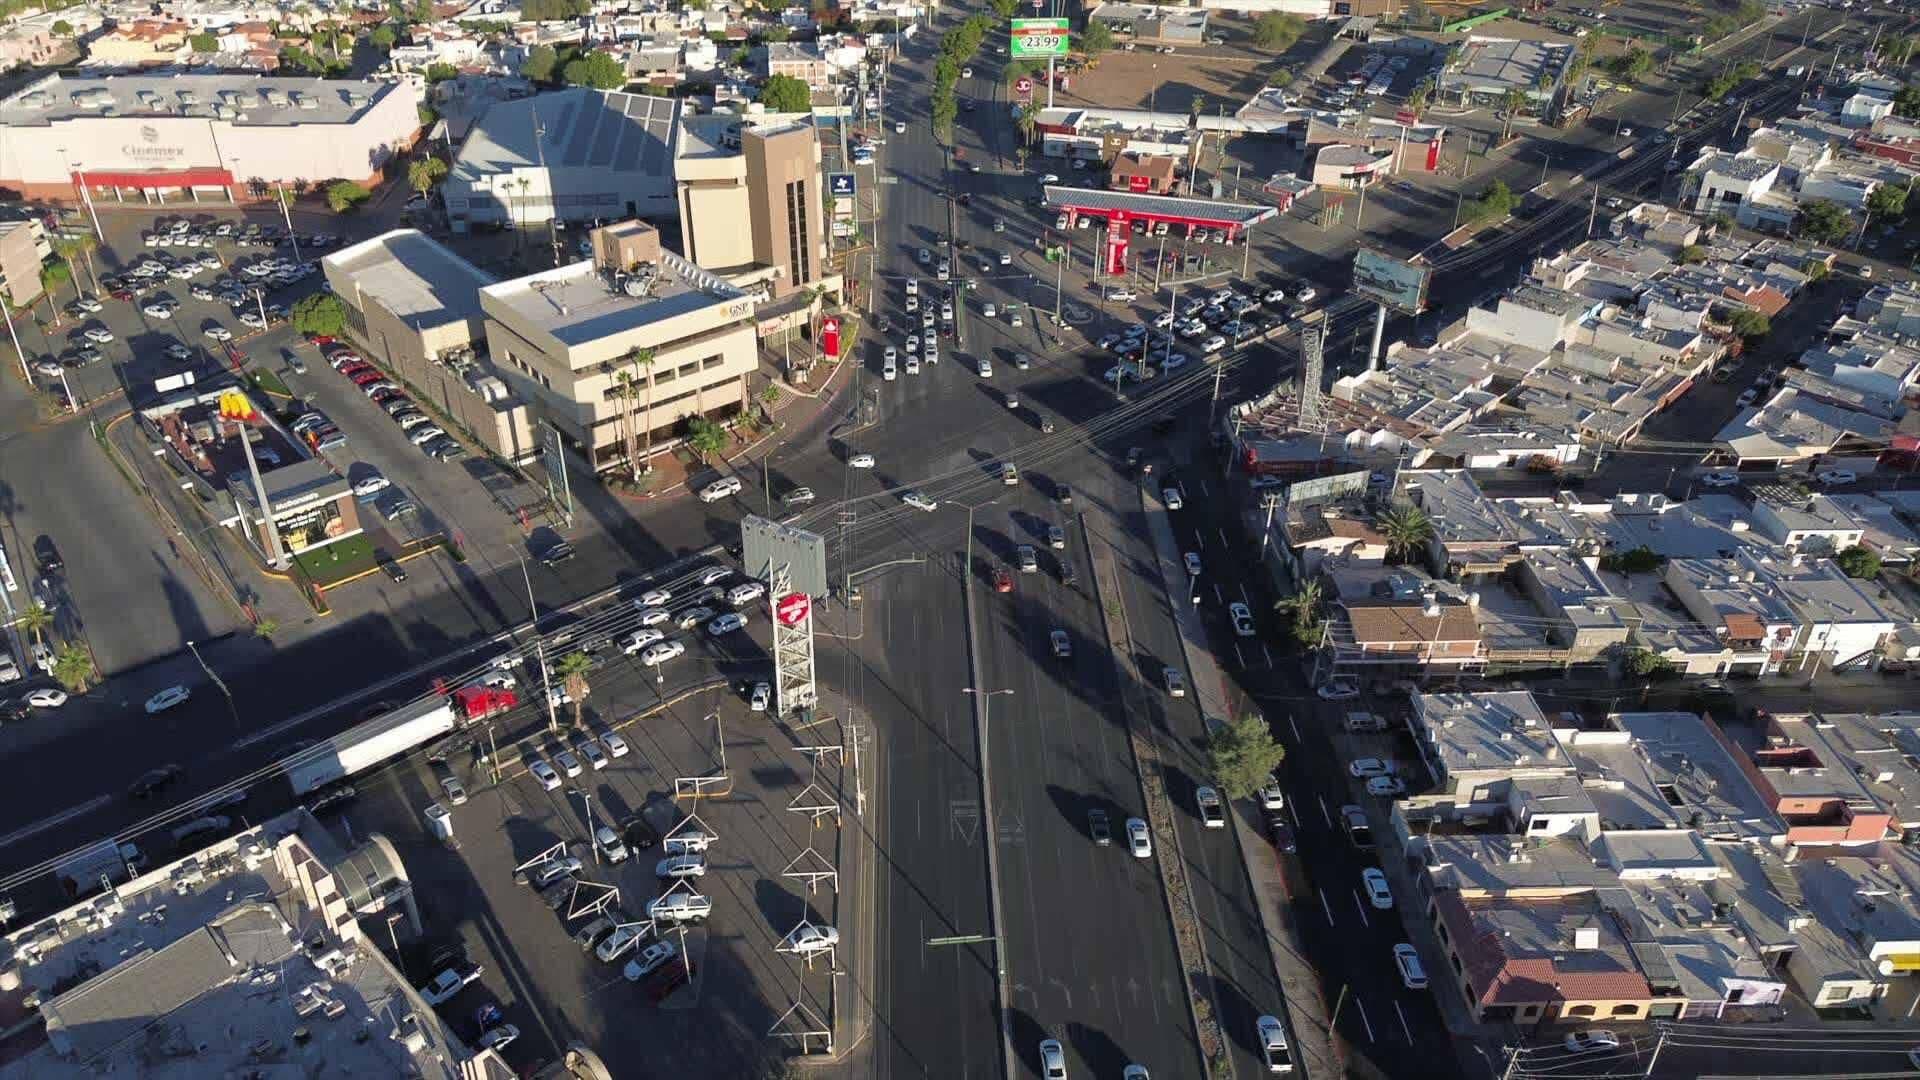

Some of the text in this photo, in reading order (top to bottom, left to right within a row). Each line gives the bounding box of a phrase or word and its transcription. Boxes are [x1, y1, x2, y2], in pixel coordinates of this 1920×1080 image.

[121, 144, 184, 156] Cinemex
[729, 303, 748, 314] GNP
[275, 492, 320, 511] McDonald's
